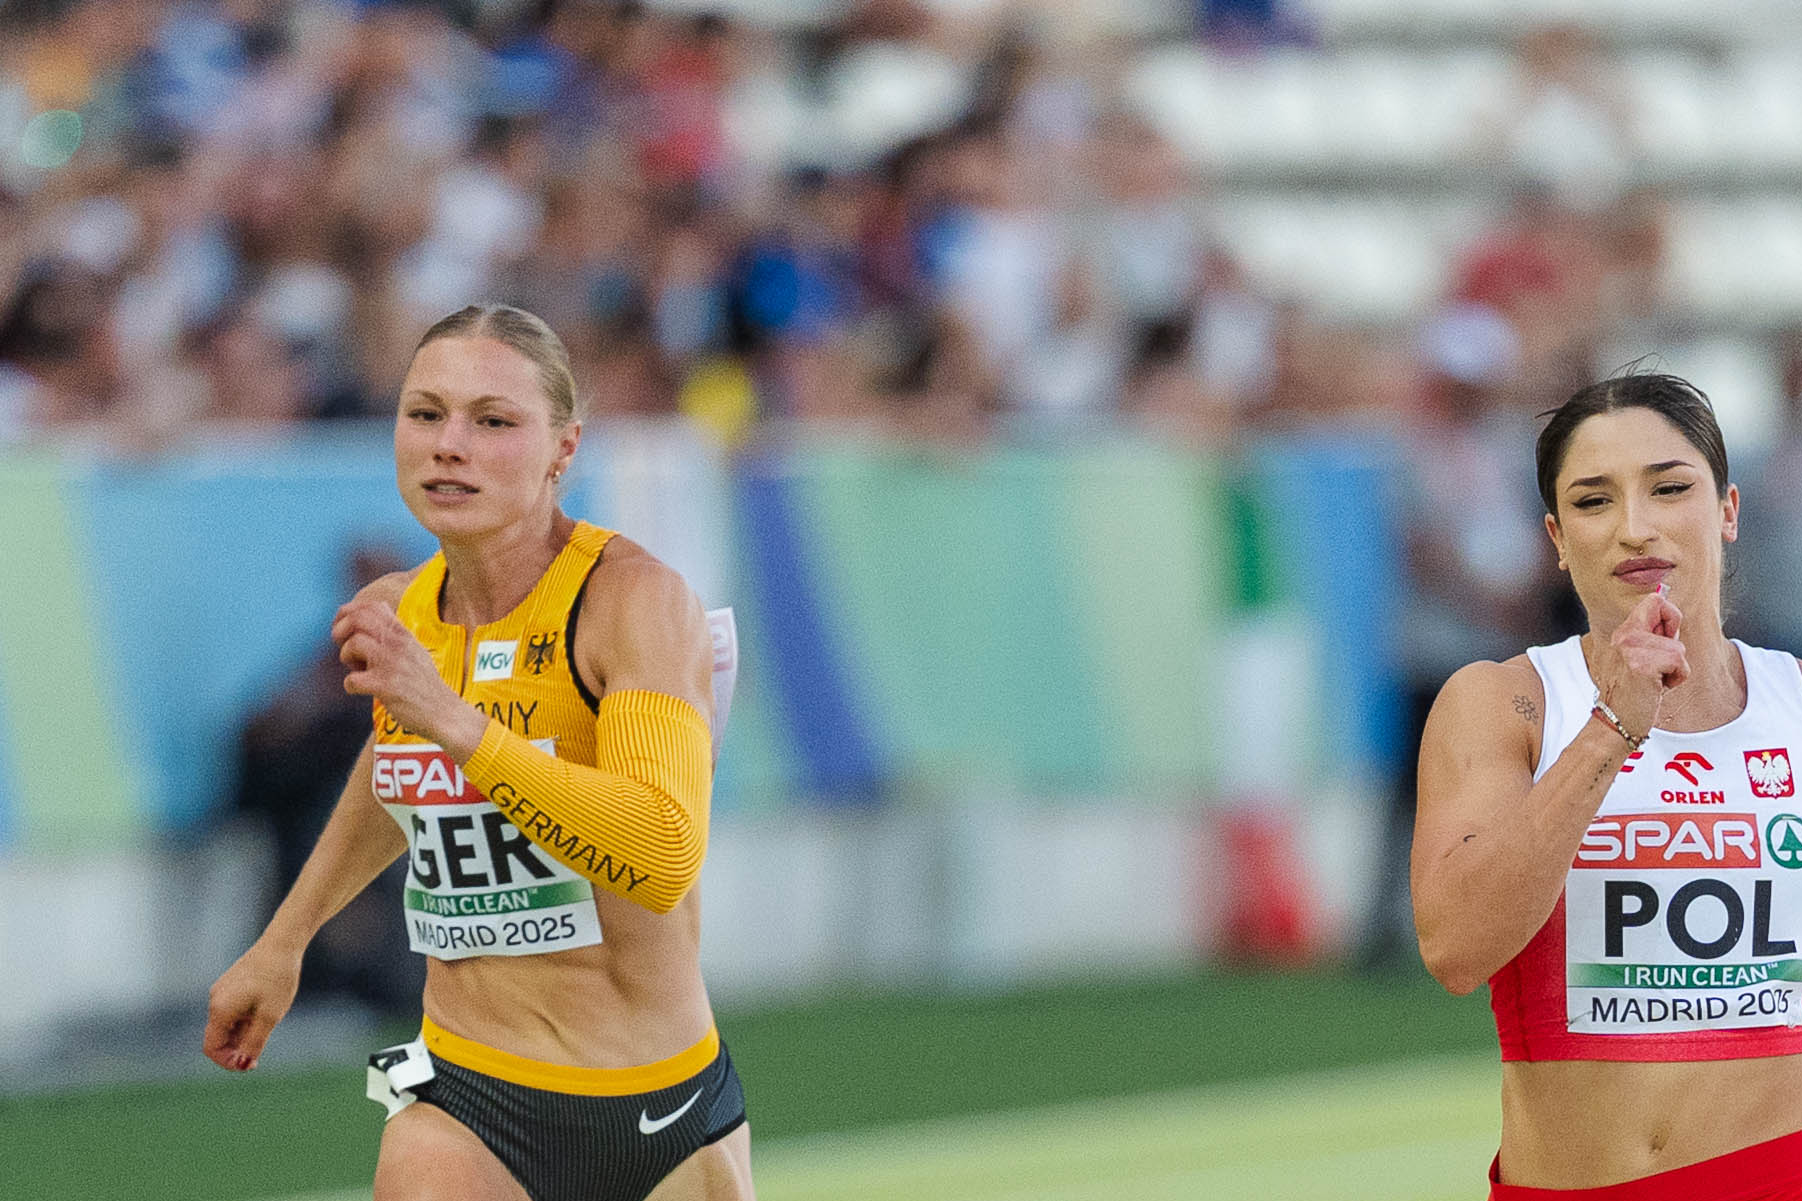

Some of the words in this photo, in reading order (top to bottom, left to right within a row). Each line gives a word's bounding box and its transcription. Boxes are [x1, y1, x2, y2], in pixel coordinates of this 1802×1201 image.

[477, 651, 513, 671] WGV
[1660, 790, 1725, 804] ORLEN
[412, 811, 556, 889] GER
[490, 782, 650, 892] GERMANY
[1577, 820, 1756, 861] SPAR
[414, 919, 496, 950] MADRID
[502, 913, 576, 946] 2025
[1604, 879, 1797, 959] POL
[1636, 967, 1686, 986] RUN
[1591, 996, 1728, 1023] MADRID
